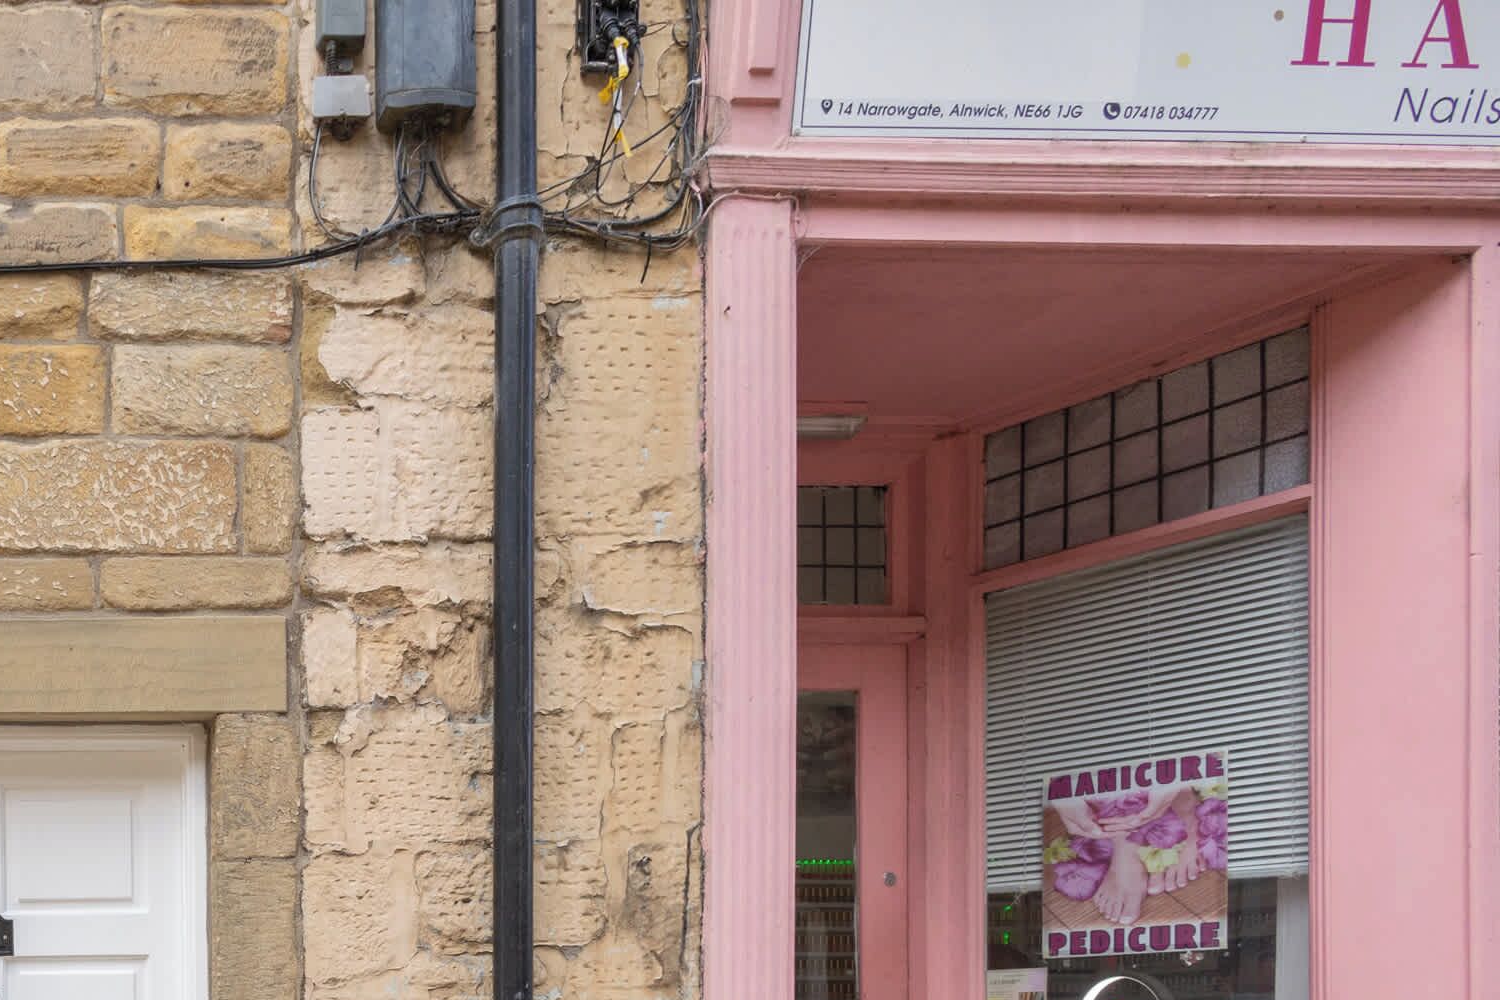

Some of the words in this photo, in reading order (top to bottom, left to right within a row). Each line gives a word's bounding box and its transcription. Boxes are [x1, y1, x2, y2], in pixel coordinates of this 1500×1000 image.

[838, 102, 852, 115] 14
[857, 102, 944, 119] Narrowgate,
[949, 103, 1008, 118] Alnwick,
[1014, 104, 1051, 118] NE66
[1057, 105, 1083, 118] 1JG
[1124, 106, 1164, 120] 07418
[1168, 106, 1219, 121] 034777
[1048, 752, 1225, 801] MANICURE
[1049, 921, 1221, 957] PEDICURE
